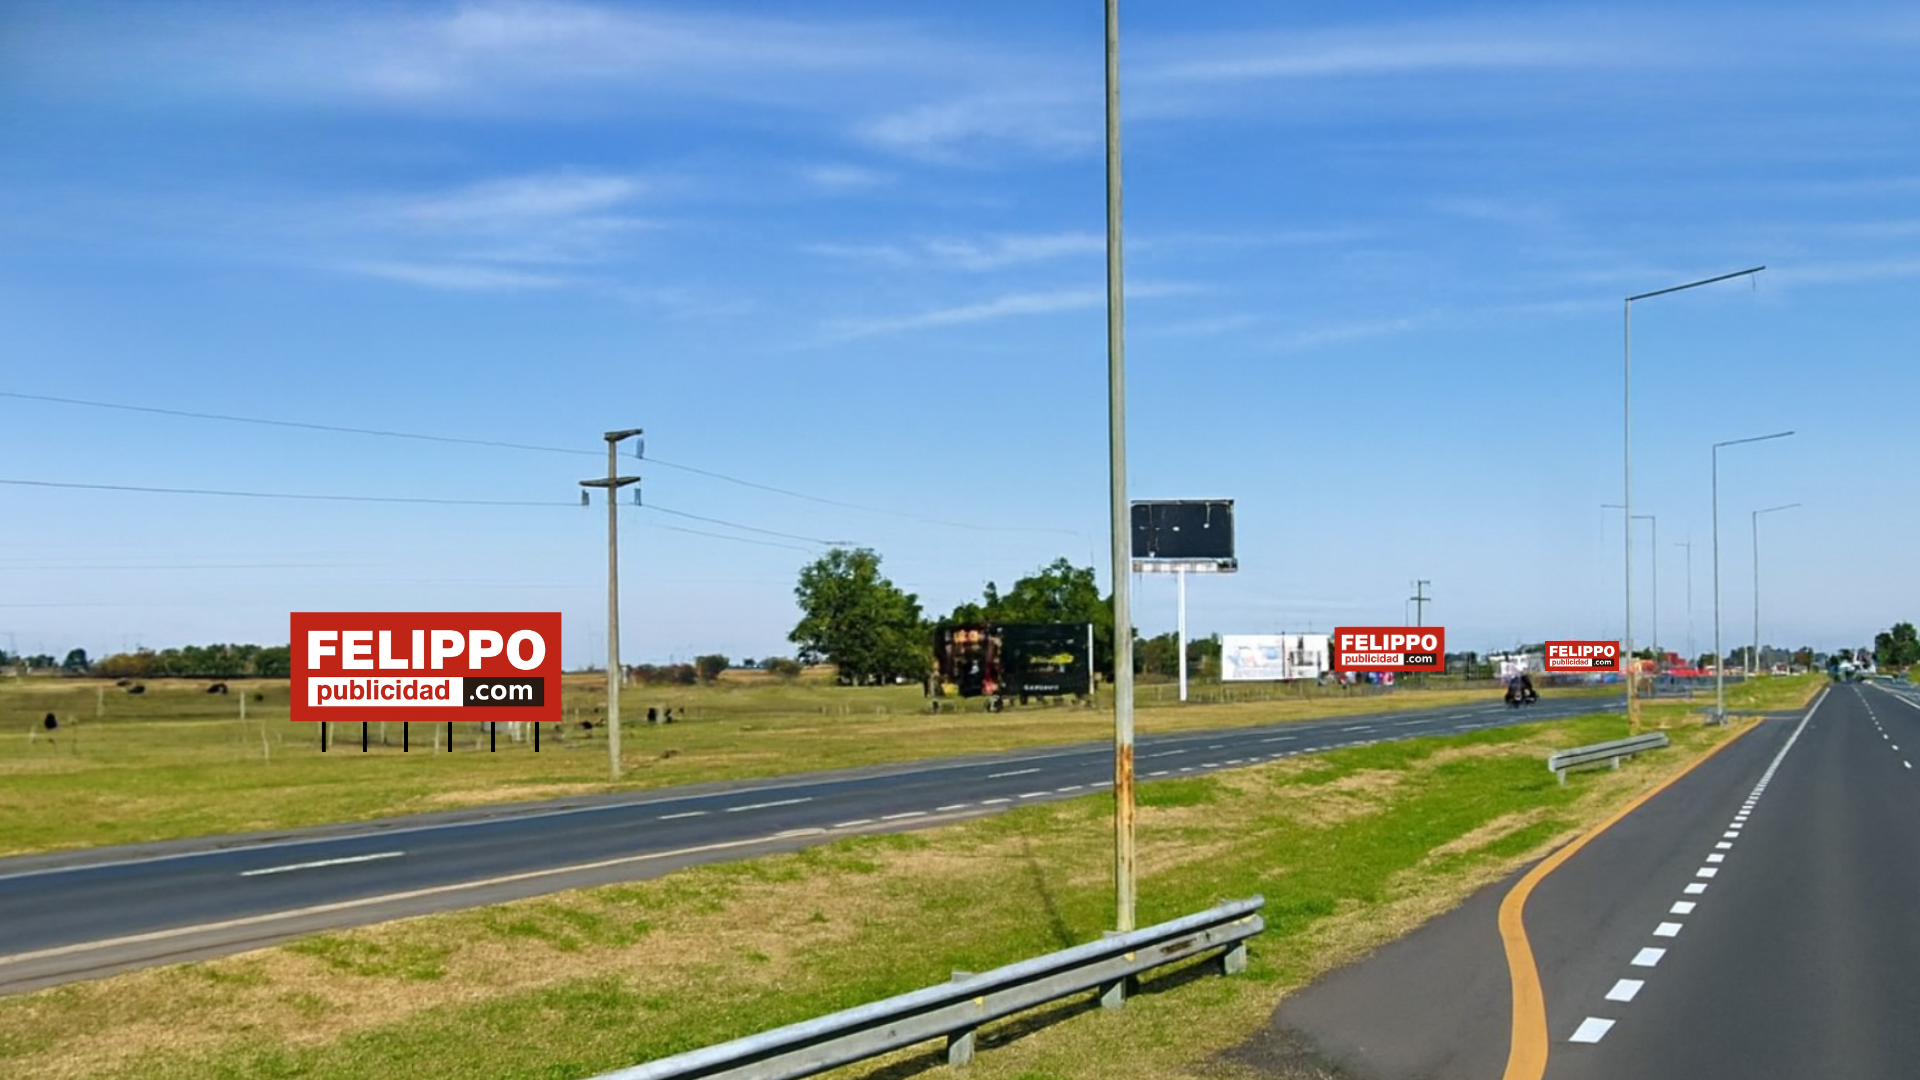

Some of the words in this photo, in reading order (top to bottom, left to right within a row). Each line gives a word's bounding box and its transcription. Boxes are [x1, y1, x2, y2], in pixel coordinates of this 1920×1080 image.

[307, 629, 547, 671] FELIPPO
[1341, 634, 1438, 651] FELIPPO
[1549, 645, 1615, 657] FELIPPO
[1345, 653, 1399, 666] publicidad
[1405, 655, 1433, 664] .com
[1552, 658, 1588, 666] publicidad
[317, 679, 450, 706] publicidad
[469, 683, 533, 701] .com
